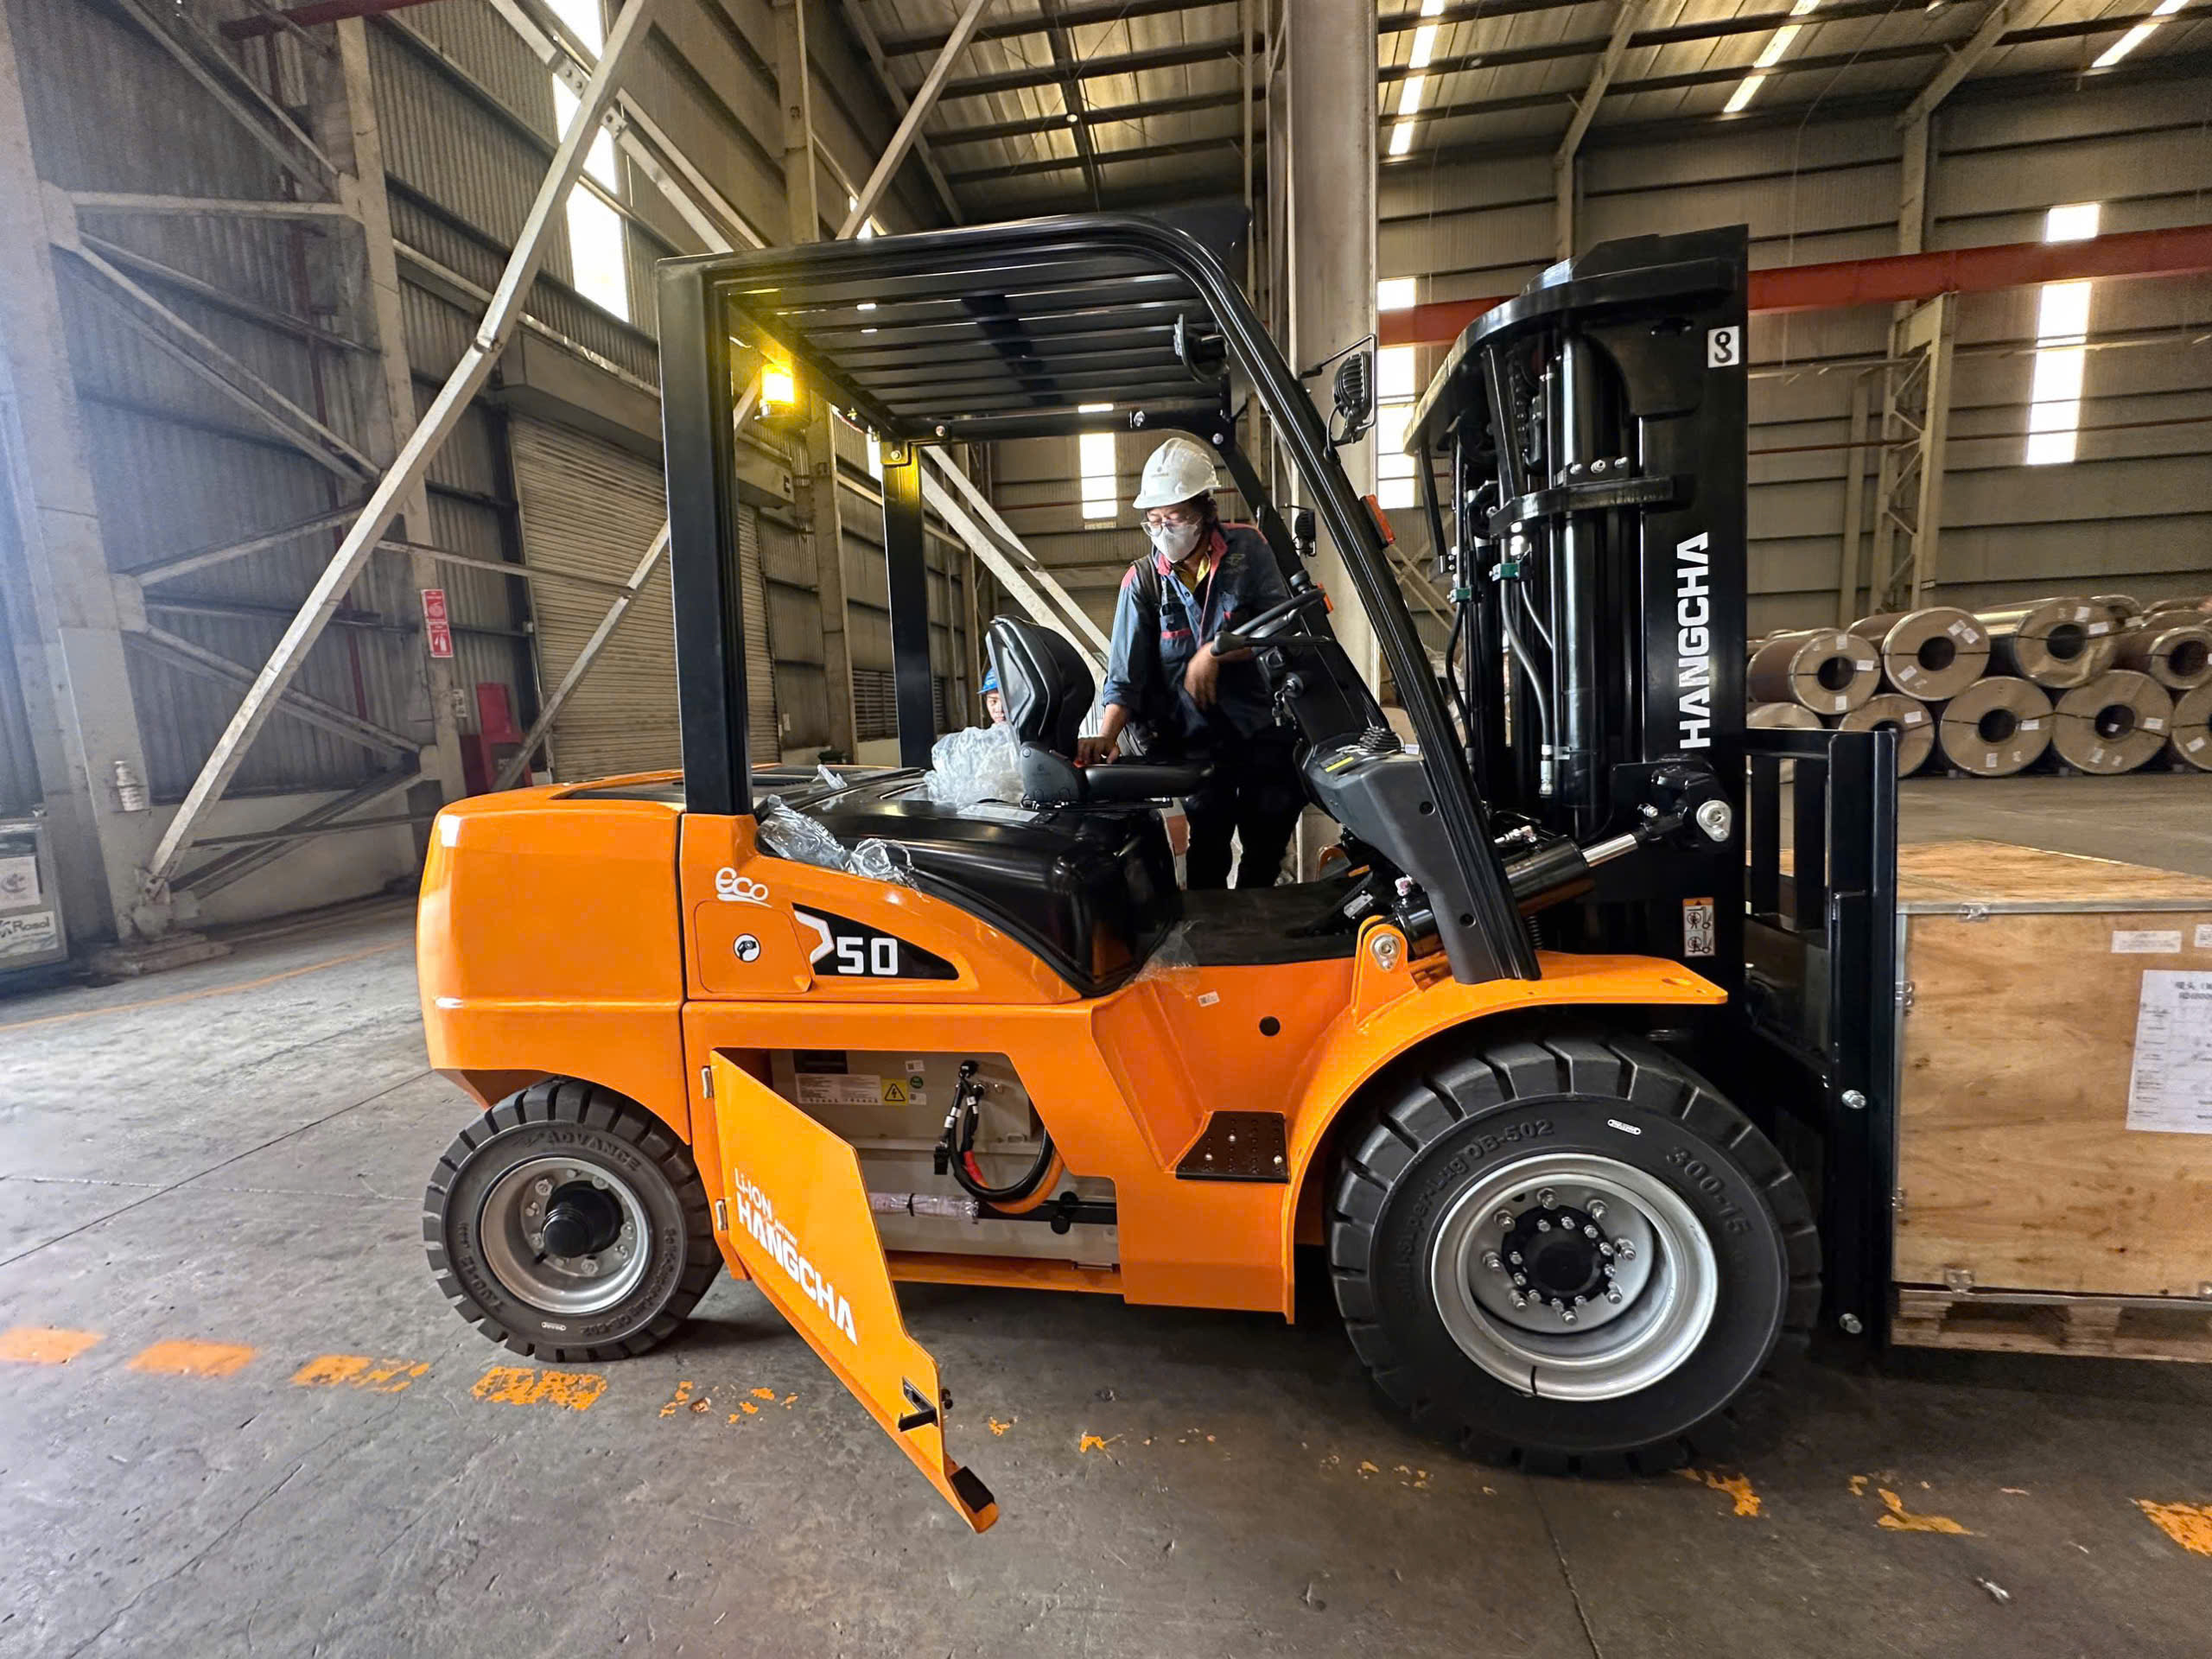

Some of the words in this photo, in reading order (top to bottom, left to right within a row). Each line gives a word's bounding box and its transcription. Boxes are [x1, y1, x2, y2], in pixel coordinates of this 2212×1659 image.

[1676, 531, 1711, 749] HANGCHA
[836, 937, 898, 976] 50
[546, 1129, 643, 1173] ADVANCE
[1664, 1144, 1753, 1235] 300-15
[736, 1191, 857, 1346] HANGCHA
